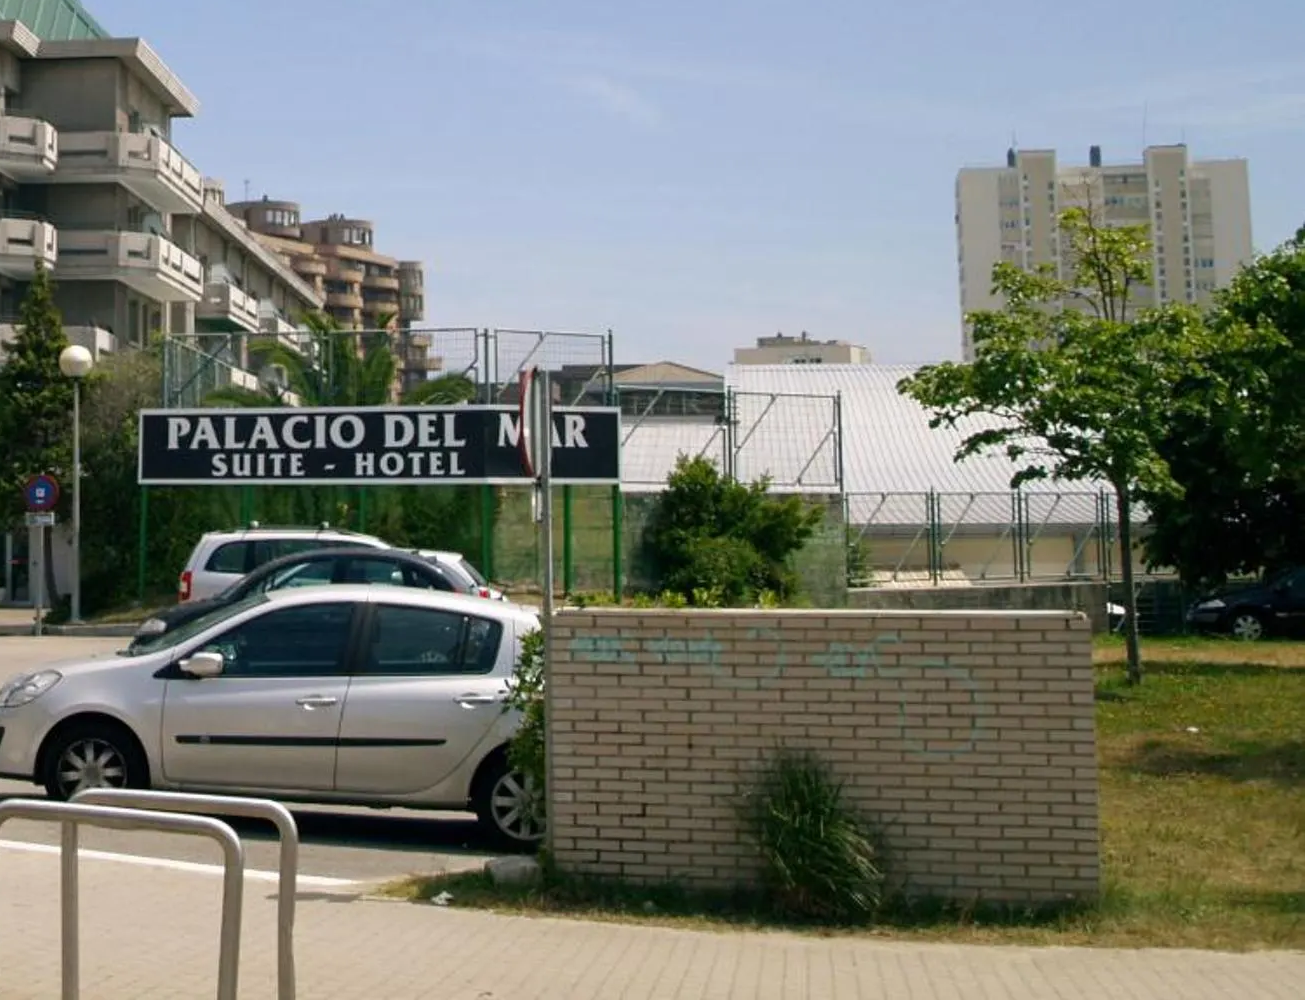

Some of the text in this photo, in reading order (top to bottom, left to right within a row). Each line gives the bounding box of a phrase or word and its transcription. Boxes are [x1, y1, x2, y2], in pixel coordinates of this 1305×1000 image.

[167, 415, 365, 450] PALACIO
[384, 413, 466, 448] DEL
[211, 453, 305, 476] SUITE
[354, 452, 466, 476] HOTEL
